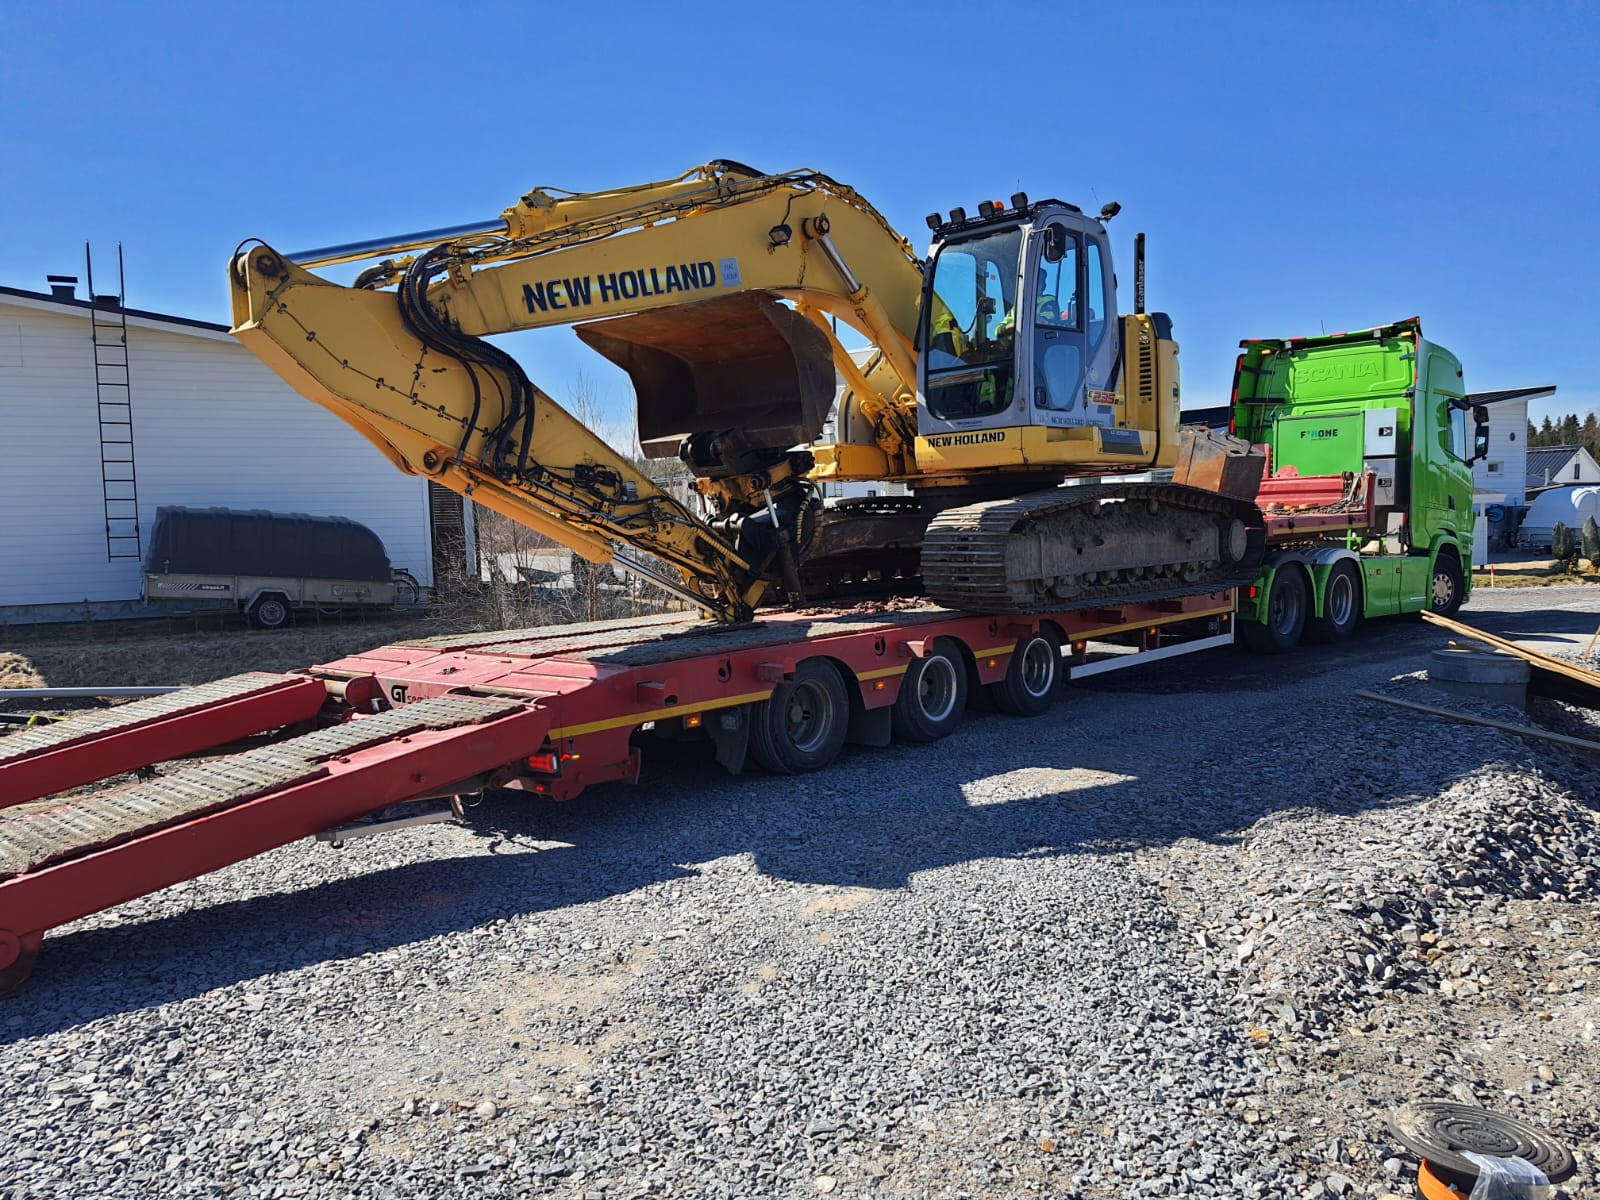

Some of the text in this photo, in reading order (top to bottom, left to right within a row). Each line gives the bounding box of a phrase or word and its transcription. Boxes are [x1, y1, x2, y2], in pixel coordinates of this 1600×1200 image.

[522, 275, 592, 314] NEW
[597, 261, 717, 303] HOLLAND
[1294, 362, 1379, 384] SCANIA
[927, 431, 1006, 448] NEW HOLLAND
[391, 684, 409, 704] GT
